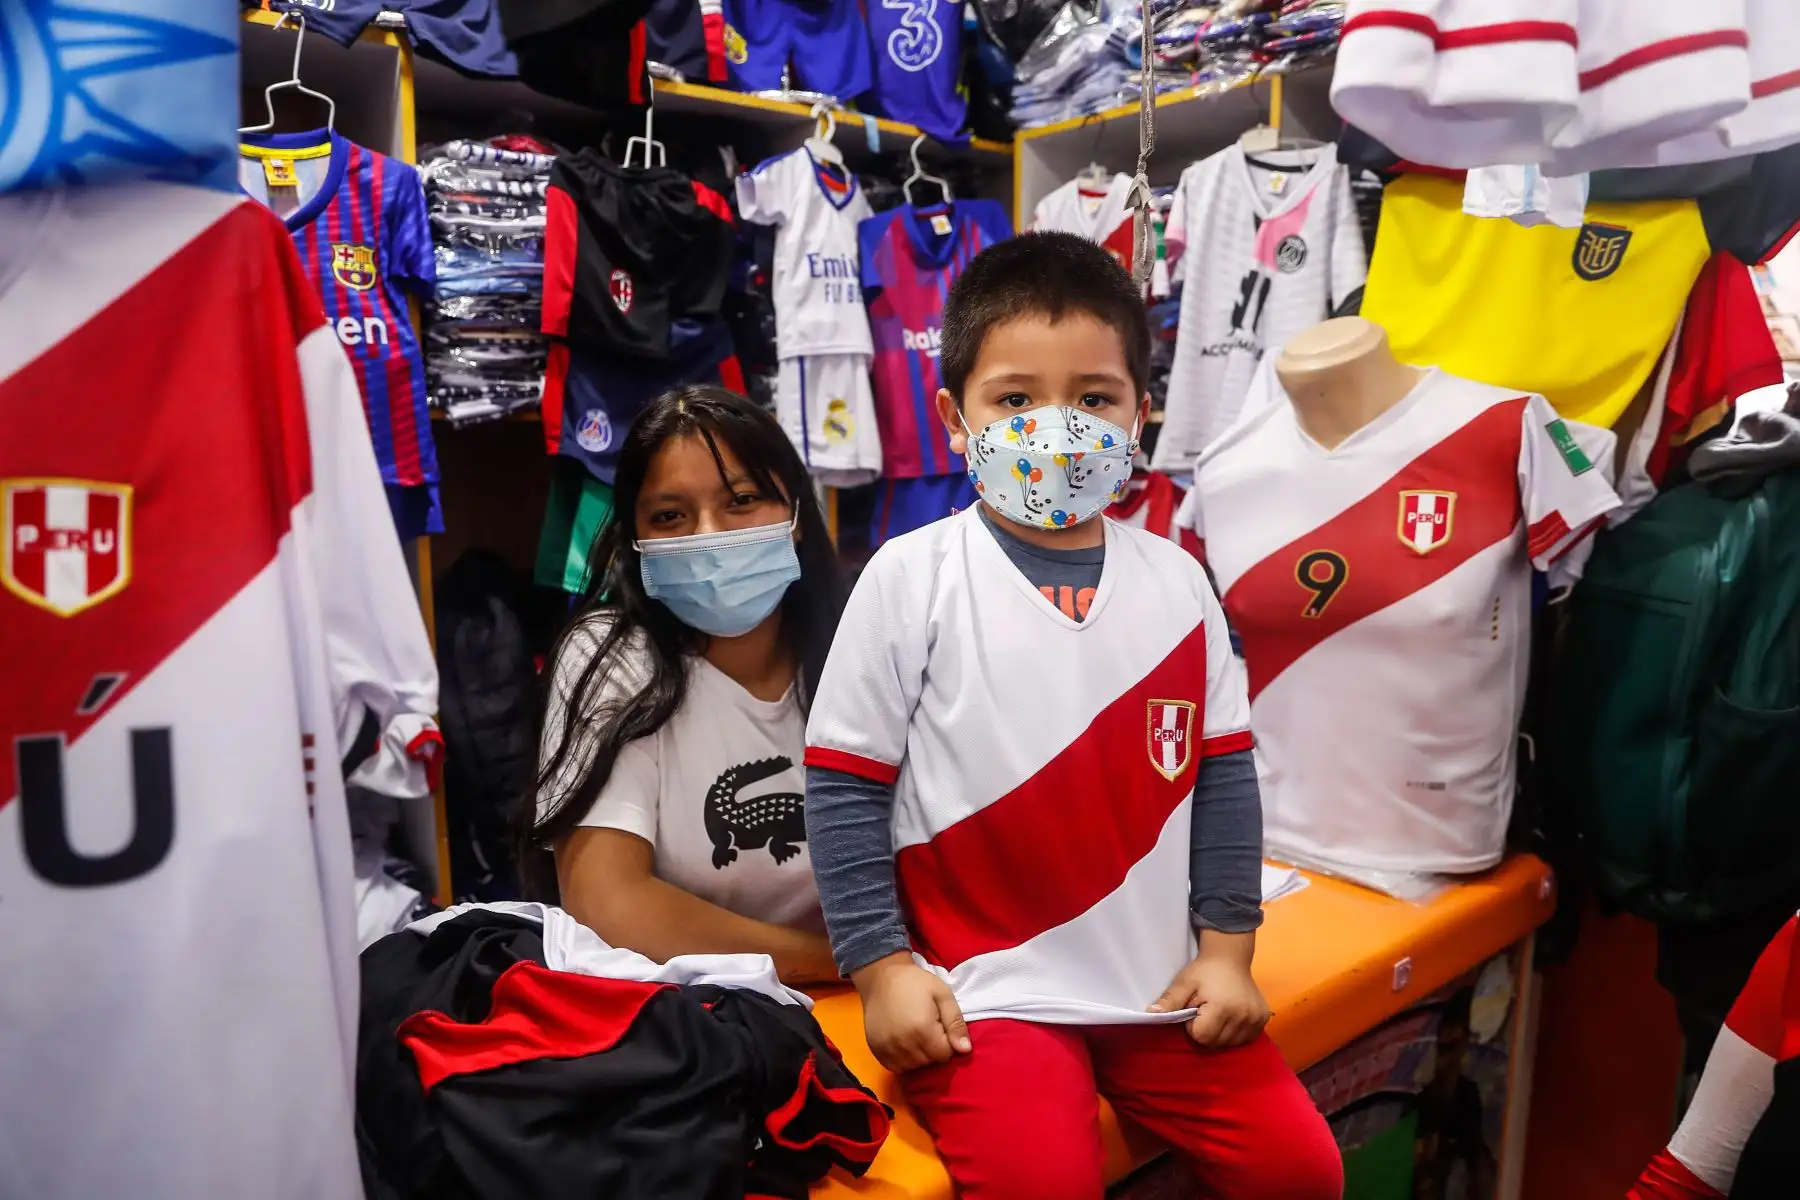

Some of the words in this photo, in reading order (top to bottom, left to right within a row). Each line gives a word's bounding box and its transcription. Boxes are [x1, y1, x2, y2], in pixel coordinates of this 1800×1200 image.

[882, 0, 943, 72] 3
[326, 316, 388, 345] en
[1407, 511, 1444, 525] PERU
[1294, 549, 1349, 618] 9
[1154, 727, 1184, 742] PERU
